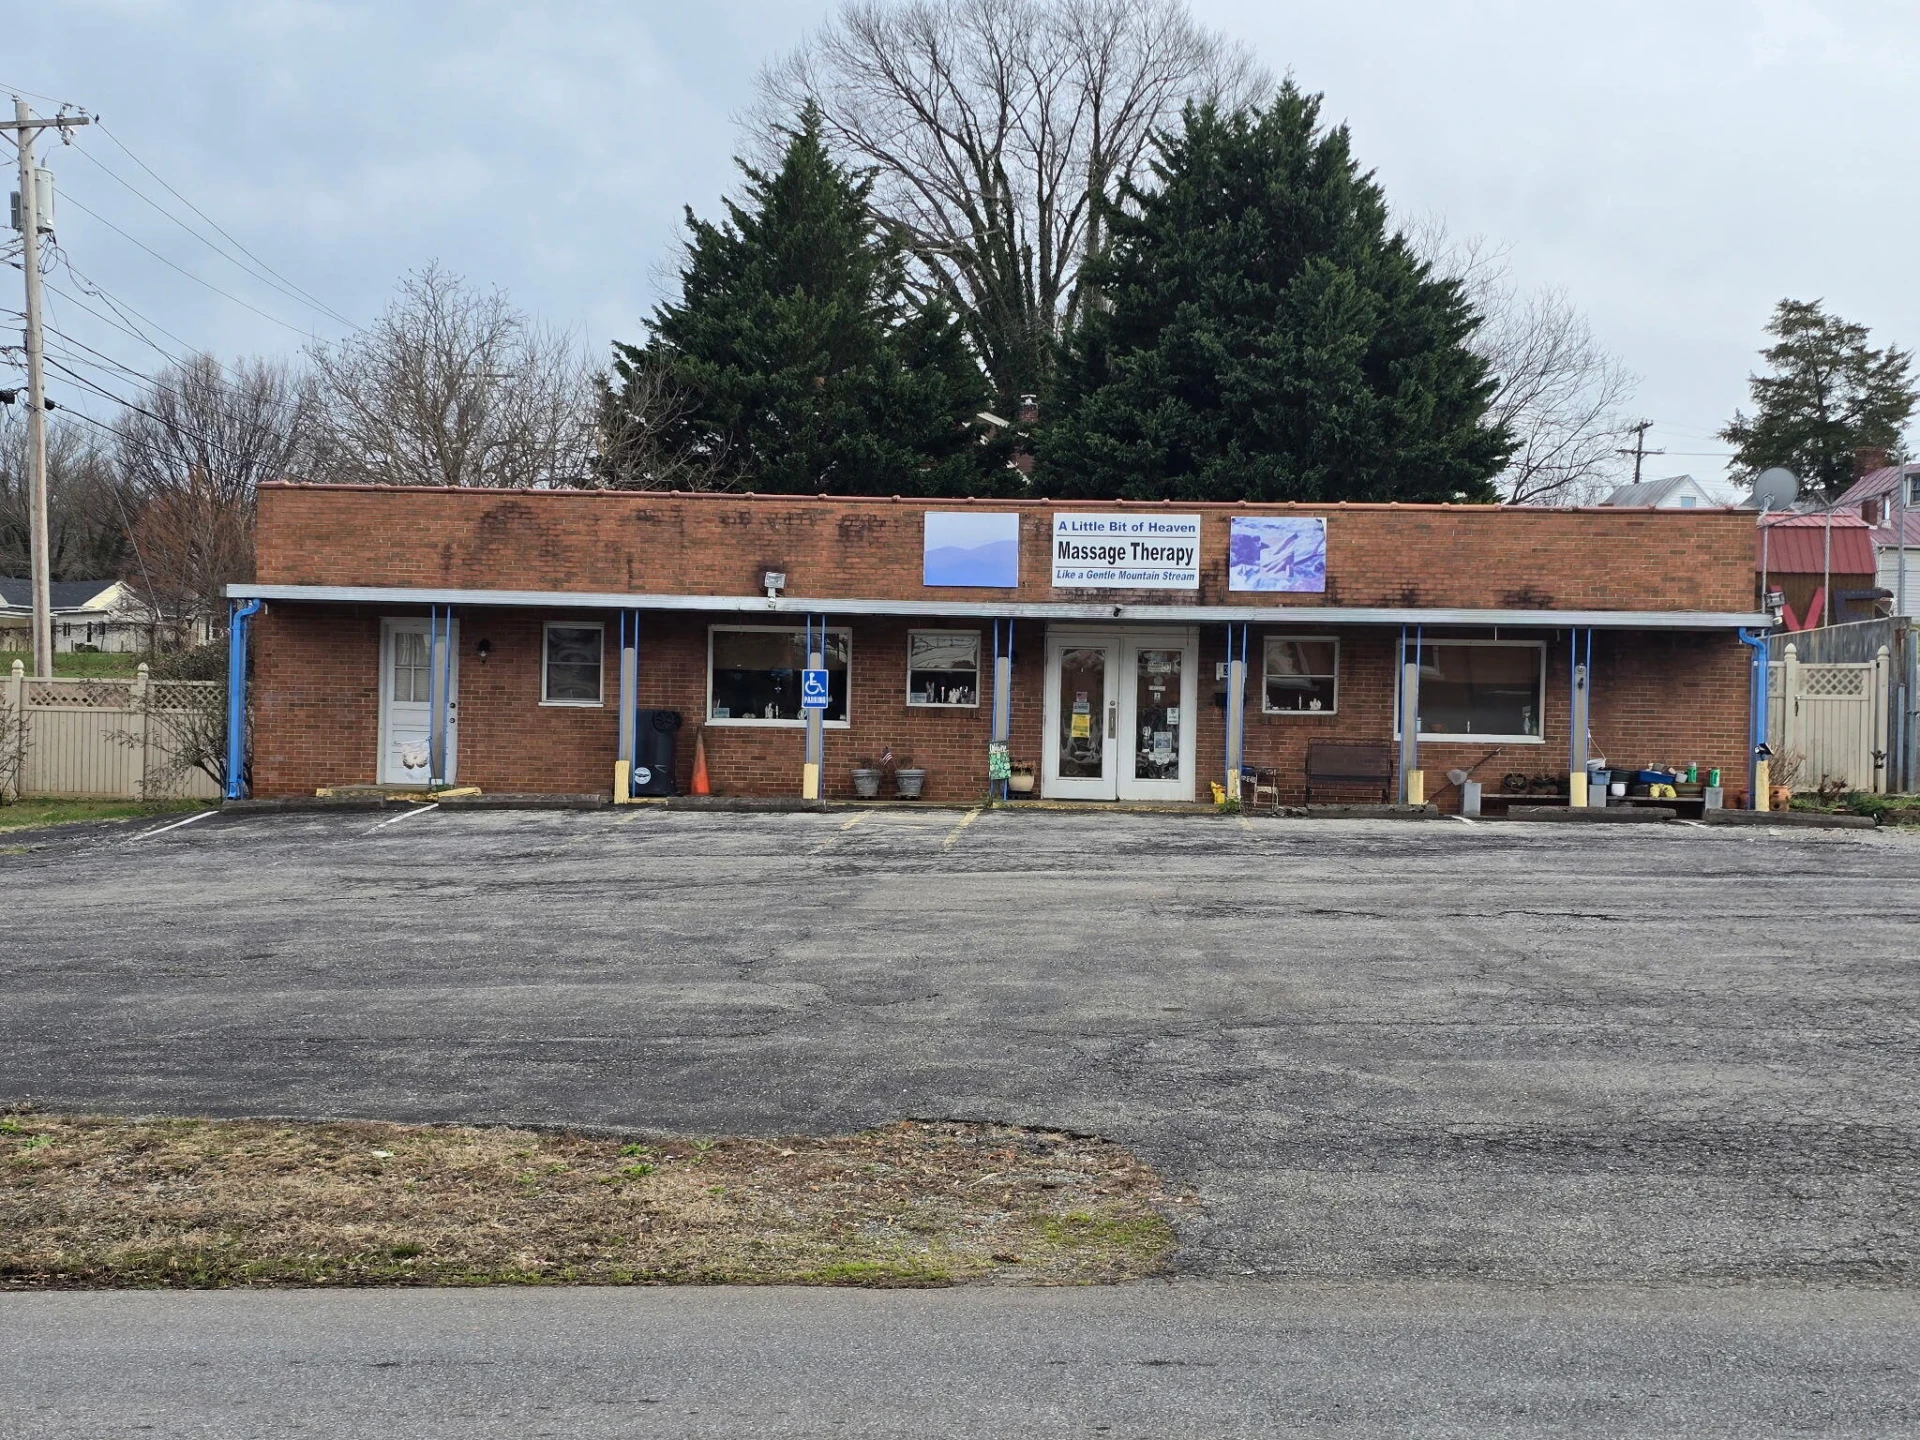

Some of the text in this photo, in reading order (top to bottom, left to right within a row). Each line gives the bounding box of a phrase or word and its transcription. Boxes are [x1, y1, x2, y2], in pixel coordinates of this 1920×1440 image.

[1058, 521, 1196, 533] A Little Bit of Heaven
[1058, 541, 1194, 566] Massage Therapy
[1056, 569, 1076, 579] Like
[1086, 570, 1116, 580] Gentle
[1118, 570, 1160, 580] Mountain
[1162, 571, 1195, 581] Stream
[804, 696, 826, 704] PARKING
